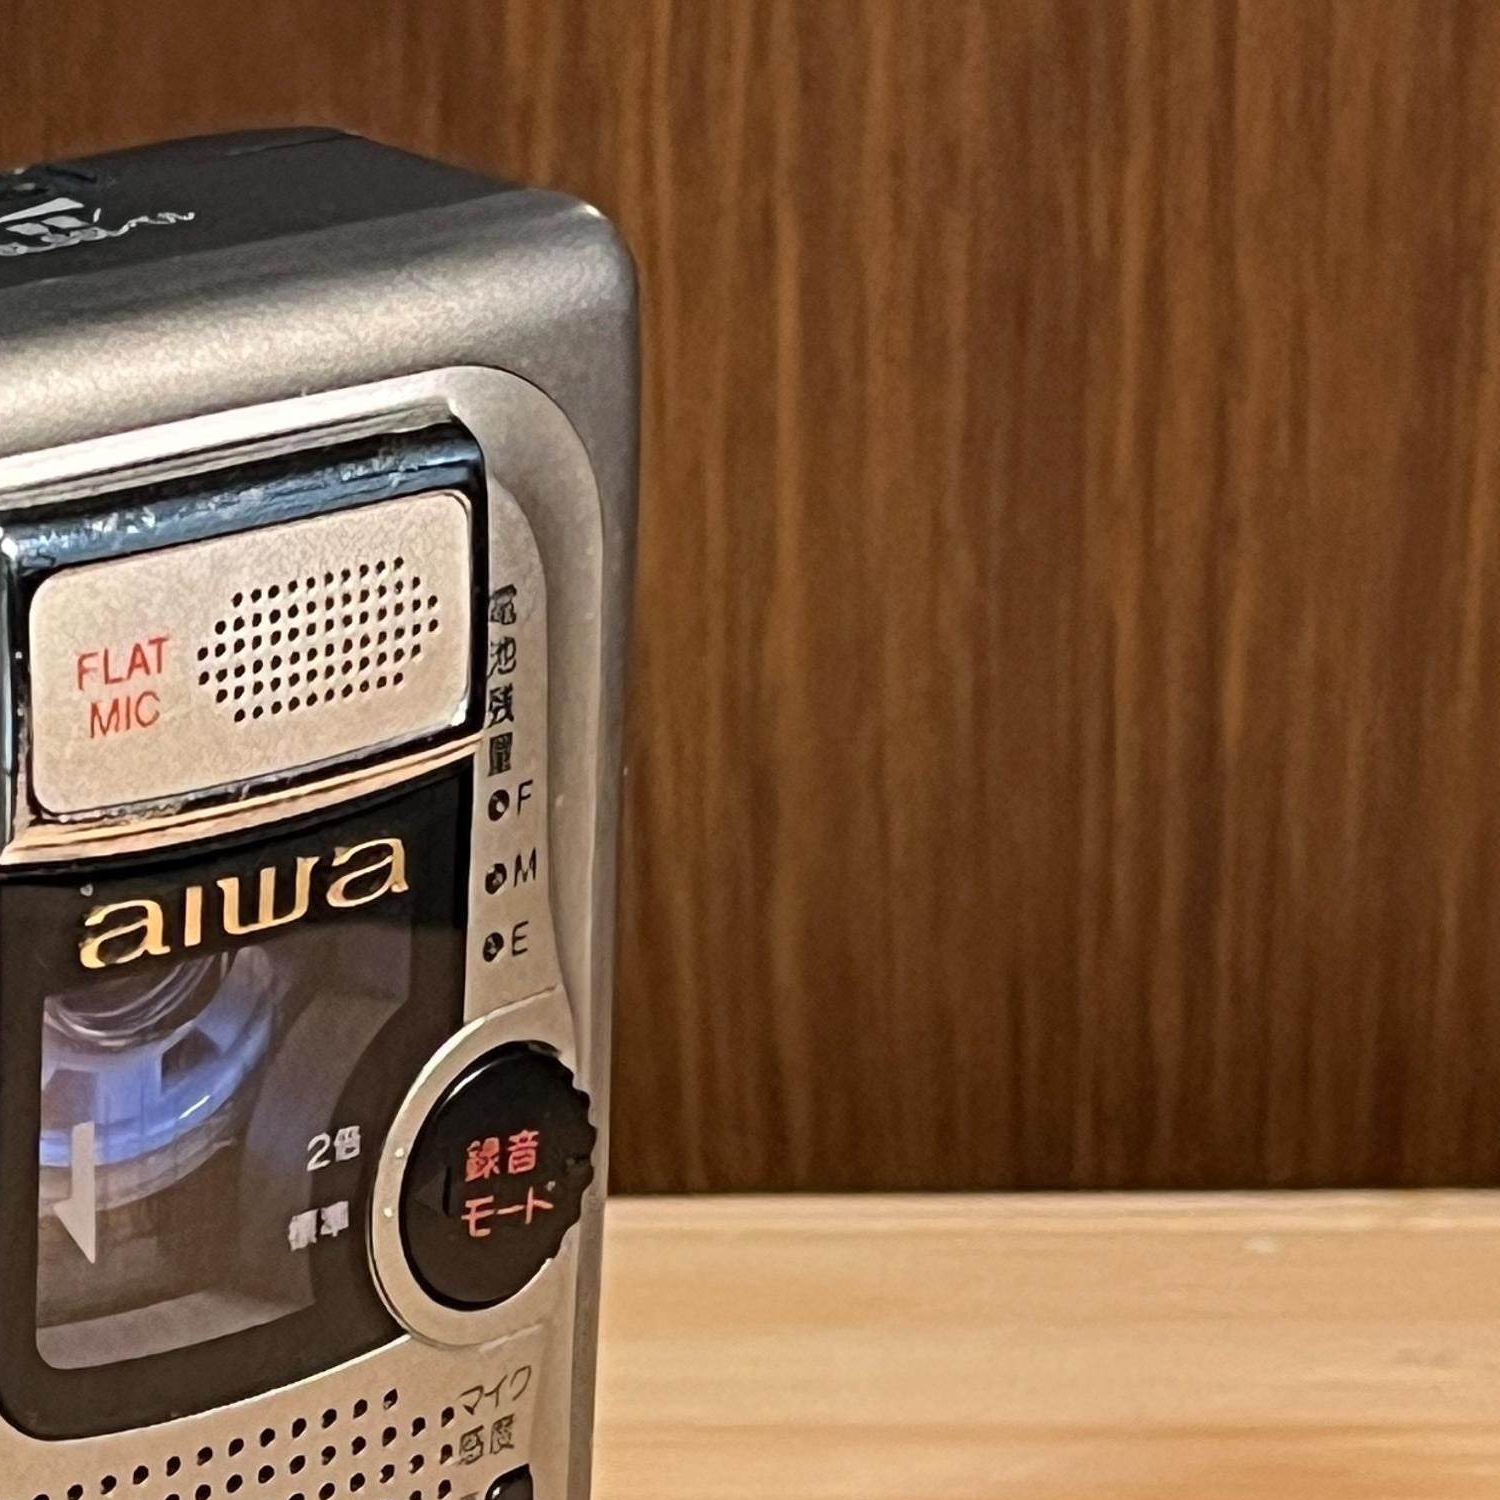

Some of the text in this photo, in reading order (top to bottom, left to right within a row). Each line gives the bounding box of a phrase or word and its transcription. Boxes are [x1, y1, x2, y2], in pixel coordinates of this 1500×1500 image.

[76, 637, 170, 691] FLAT
[88, 690, 161, 739] MIC
[516, 780, 536, 816] F
[513, 849, 538, 883] M
[78, 836, 410, 970] aiwa
[511, 921, 530, 955] E
[464, 1128, 540, 1183] 録音
[459, 1364, 533, 1416] マイク
